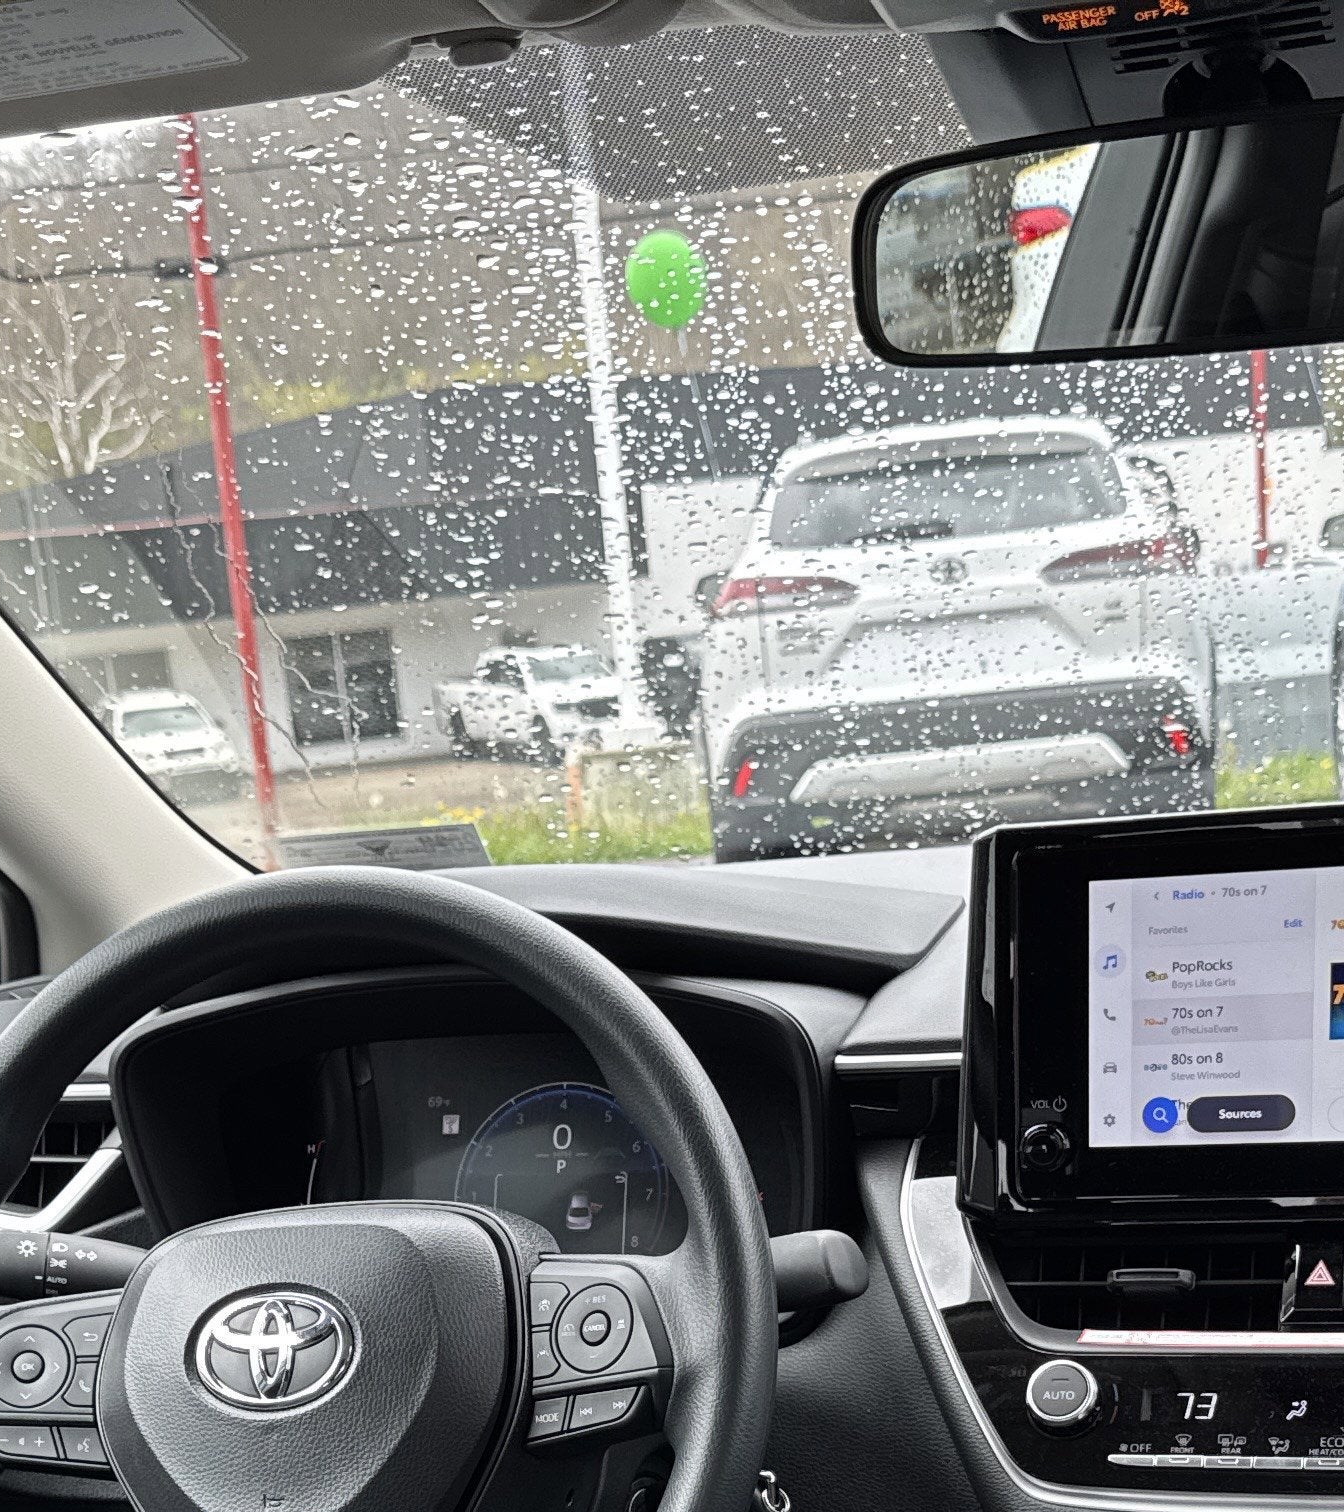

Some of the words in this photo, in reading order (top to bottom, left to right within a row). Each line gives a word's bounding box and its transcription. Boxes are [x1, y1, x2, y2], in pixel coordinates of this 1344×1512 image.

[1042, 6, 1116, 24] PASSENGER
[1135, 9, 1160, 21] OFF
[1058, 19, 1078, 31] AIR
[1081, 17, 1108, 29] BAG
[1173, 889, 1205, 900] Radio
[1222, 887, 1241, 898] 70s
[1244, 888, 1258, 897] on
[1260, 885, 1267, 895] 7
[1284, 919, 1303, 929] Edit
[1148, 925, 1188, 936] Favorites
[1172, 958, 1233, 975] PopRocks
[1171, 980, 1193, 991] Boys
[1195, 978, 1213, 989] Like
[1215, 977, 1236, 988] Girls
[1172, 1007, 1193, 1019] 70s
[1196, 1008, 1213, 1018] on
[1216, 1006, 1224, 1017] 7
[1171, 1025, 1239, 1036] @TheLisaEvans
[1171, 1053, 1193, 1065] 80s
[1196, 1054, 1213, 1064] on
[1216, 1052, 1223, 1064] 8
[1171, 1071, 1195, 1081] Steve
[1197, 1070, 1240, 1080] Winwood
[560, 1100, 568, 1110] 4
[1031, 1100, 1050, 1109] VOL
[516, 1114, 525, 1125] 3
[605, 1112, 613, 1123] 5
[1218, 1109, 1262, 1120] Sources
[553, 1124, 572, 1150] 0
[485, 1146, 493, 1157] 2
[632, 1141, 641, 1153] 6
[556, 1159, 566, 1174] P
[645, 1188, 654, 1200] 7
[631, 1236, 639, 1248] 8
[583, 1324, 605, 1333] CANCEL
[22, 1363, 35, 1371] OK
[1043, 1391, 1075, 1400] AUTO
[1176, 1393, 1218, 1420] 73
[535, 1413, 559, 1424] MODE
[1319, 1437, 1344, 1448] ECO
[1130, 1444, 1152, 1453] OFF
